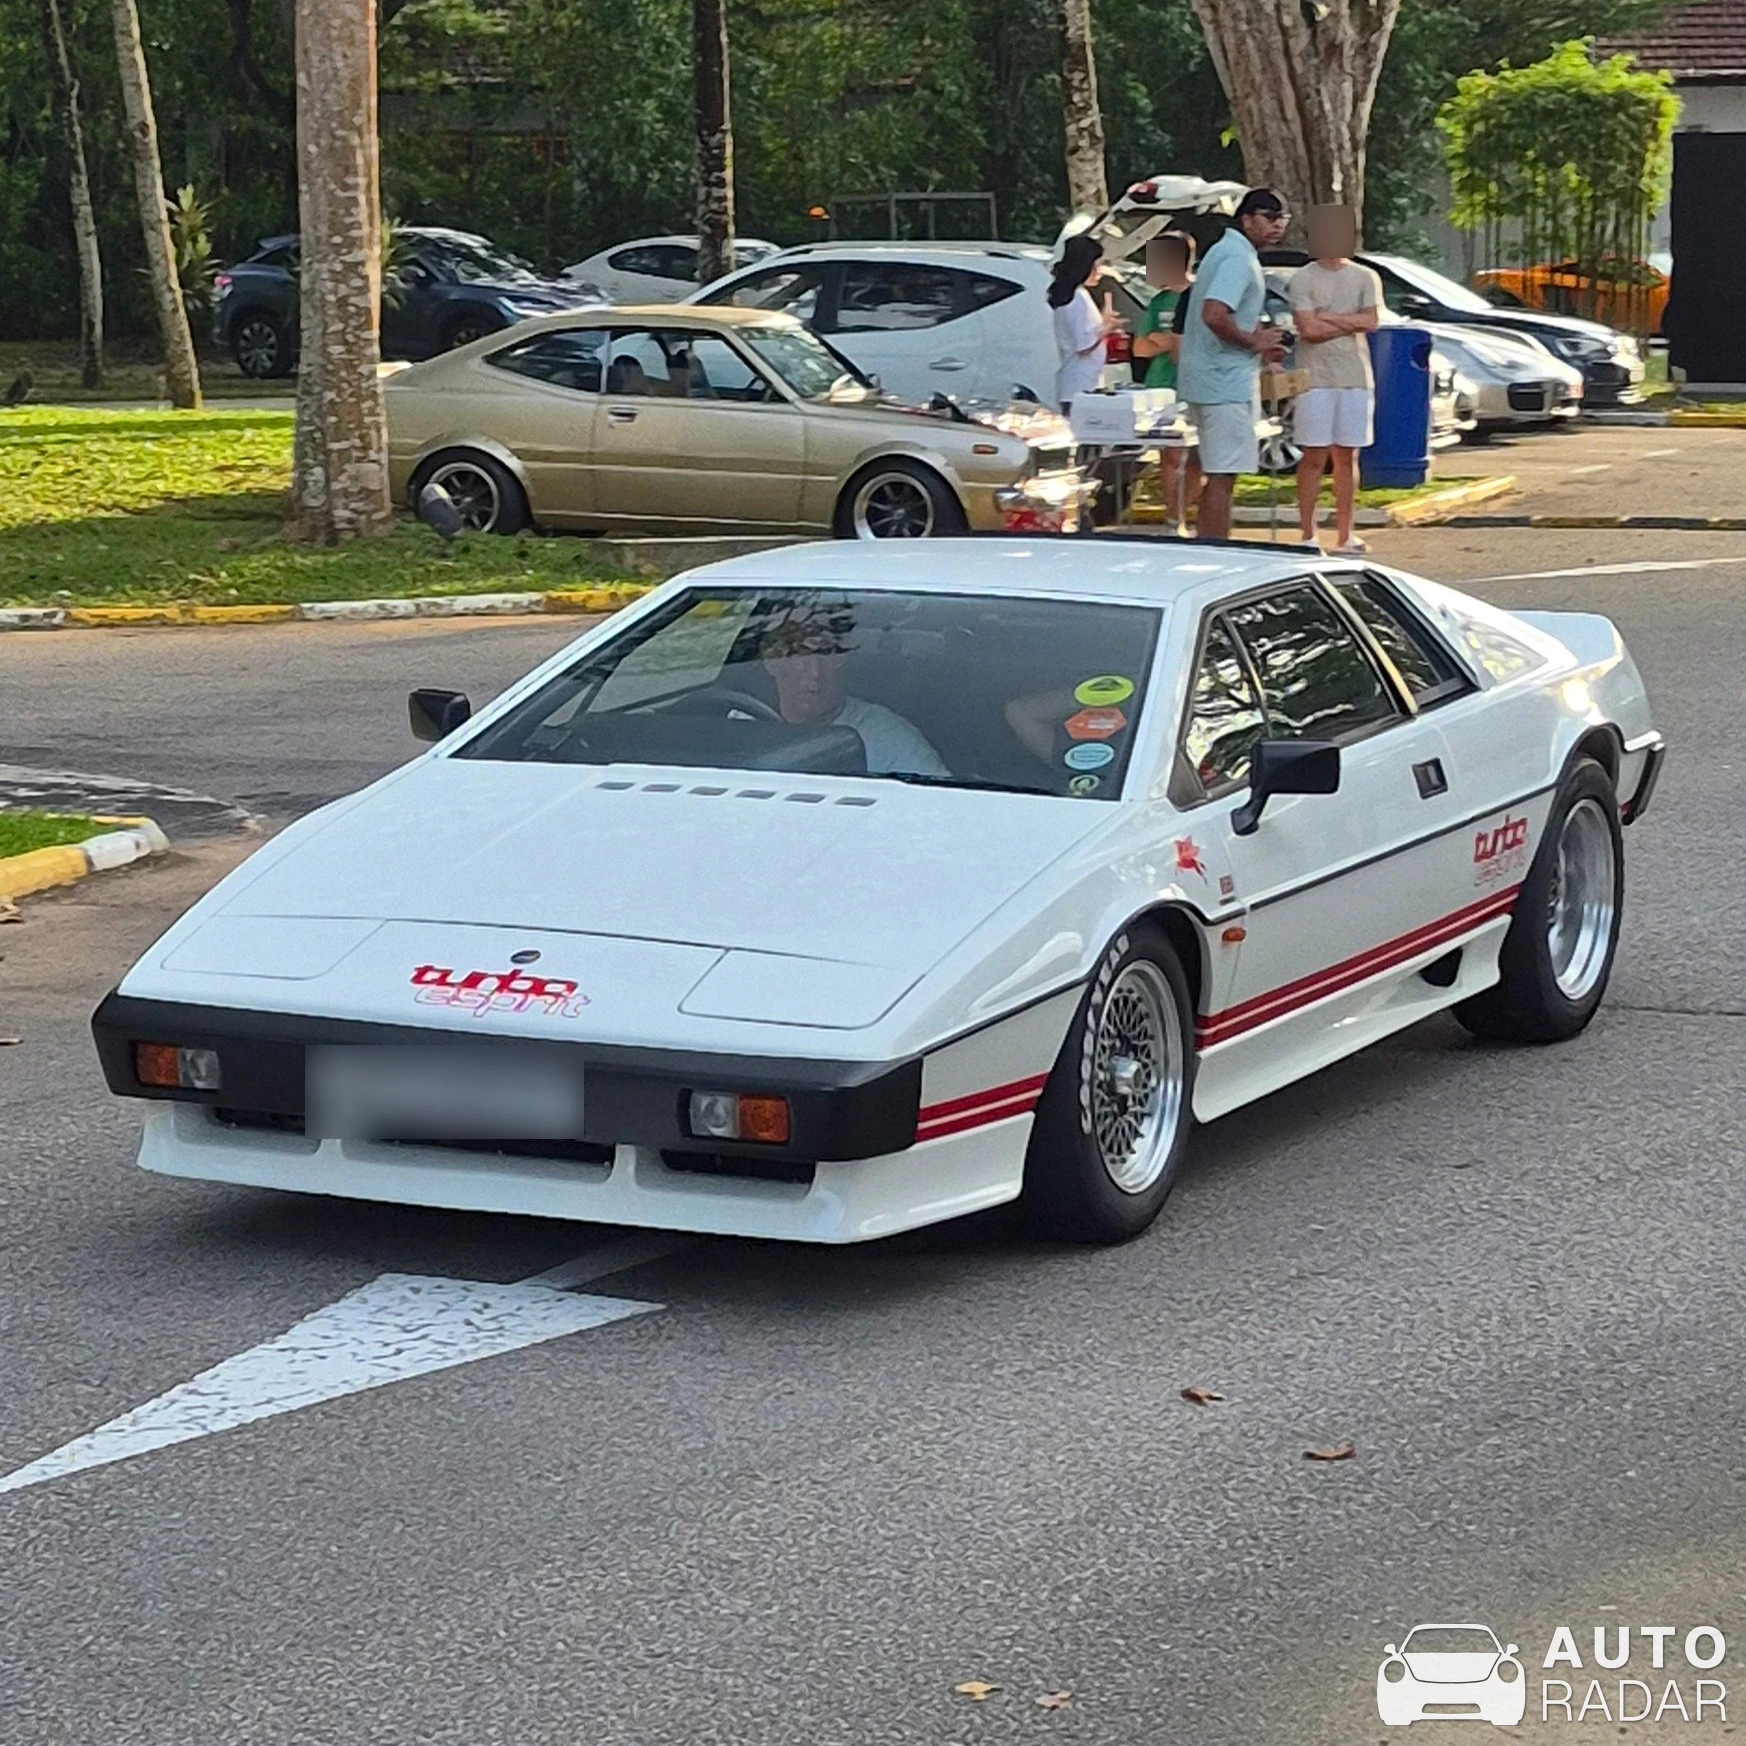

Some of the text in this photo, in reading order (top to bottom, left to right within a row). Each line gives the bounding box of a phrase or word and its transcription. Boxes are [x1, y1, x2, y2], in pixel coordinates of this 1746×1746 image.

[1473, 814, 1527, 862] turbo
[410, 965, 578, 997] turbo
[414, 986, 591, 1018] esprit
